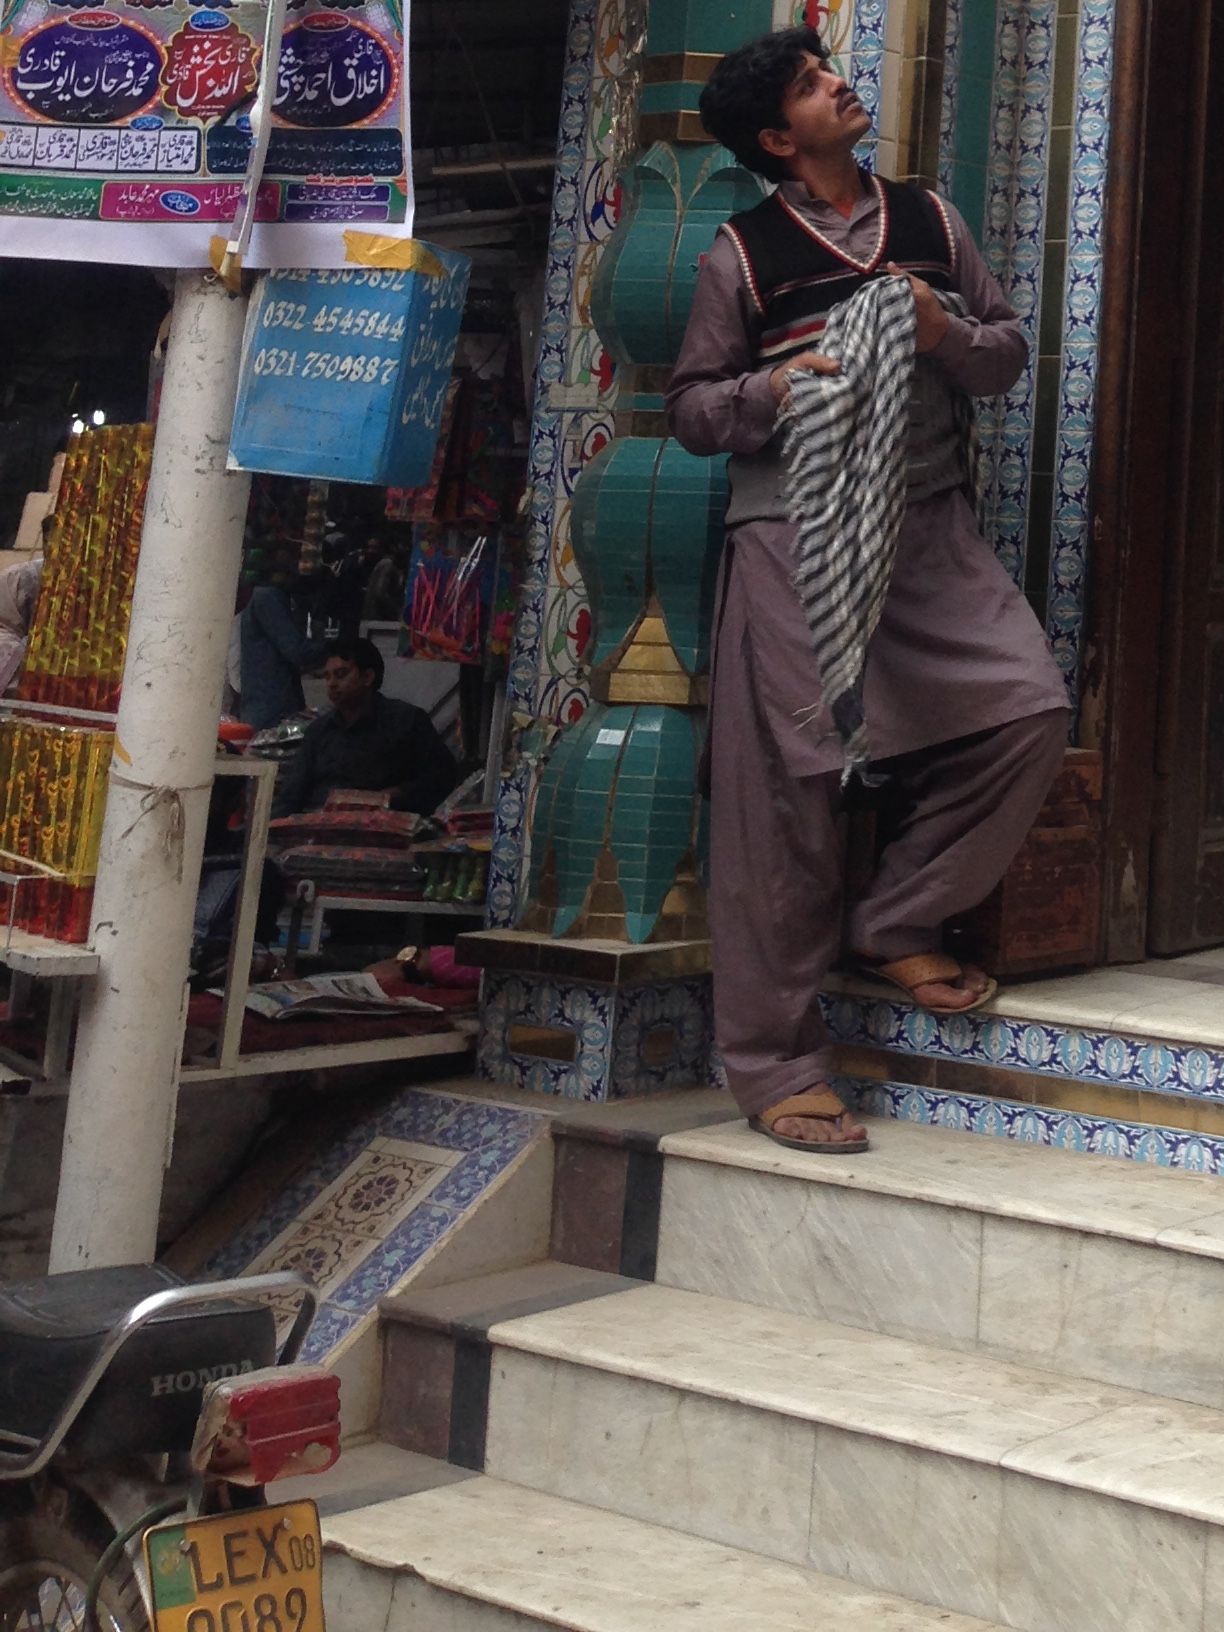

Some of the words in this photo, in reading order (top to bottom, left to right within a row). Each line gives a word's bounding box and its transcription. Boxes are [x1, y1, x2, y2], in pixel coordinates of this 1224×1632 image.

[16, 47, 66, 75] قادری
[218, 39, 250, 65] قاری
[16, 60, 77, 102] ایوب
[73, 61, 135, 98] فرحان
[123, 61, 155, 98] محمد
[295, 61, 334, 104] احمد
[329, 53, 386, 108] اخلاق
[253, 347, 400, 387] 0321-7509887
[150, 1360, 255, 1397] HONDA
[183, 1520, 290, 1594] LEX
